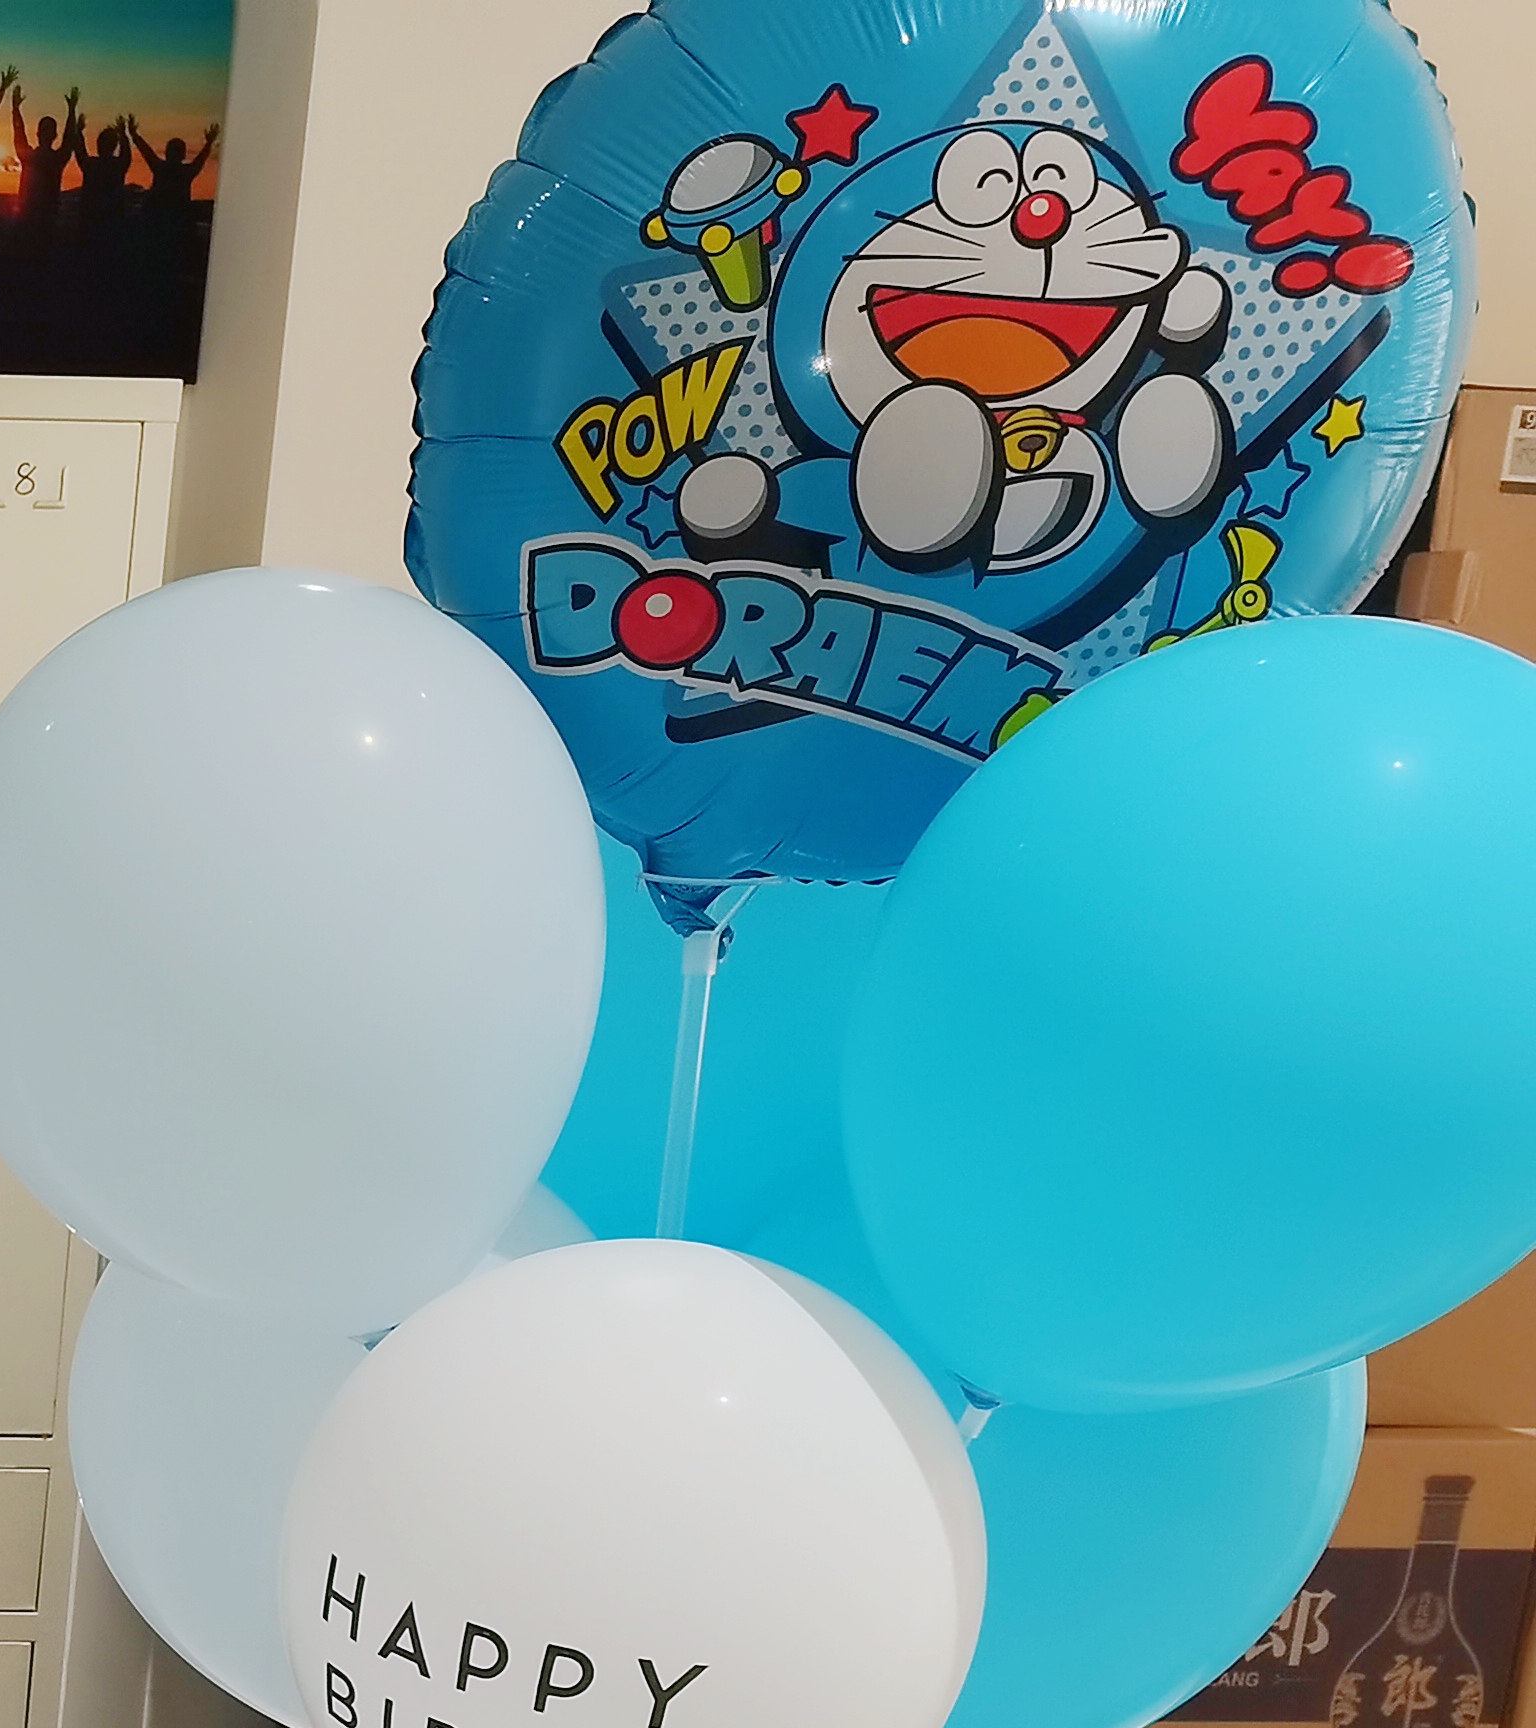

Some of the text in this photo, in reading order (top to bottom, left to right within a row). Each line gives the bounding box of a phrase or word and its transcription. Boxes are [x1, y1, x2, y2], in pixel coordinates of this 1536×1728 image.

[13, 461, 38, 498] 8
[554, 335, 756, 522] POW
[525, 542, 1075, 764] DORAEM
